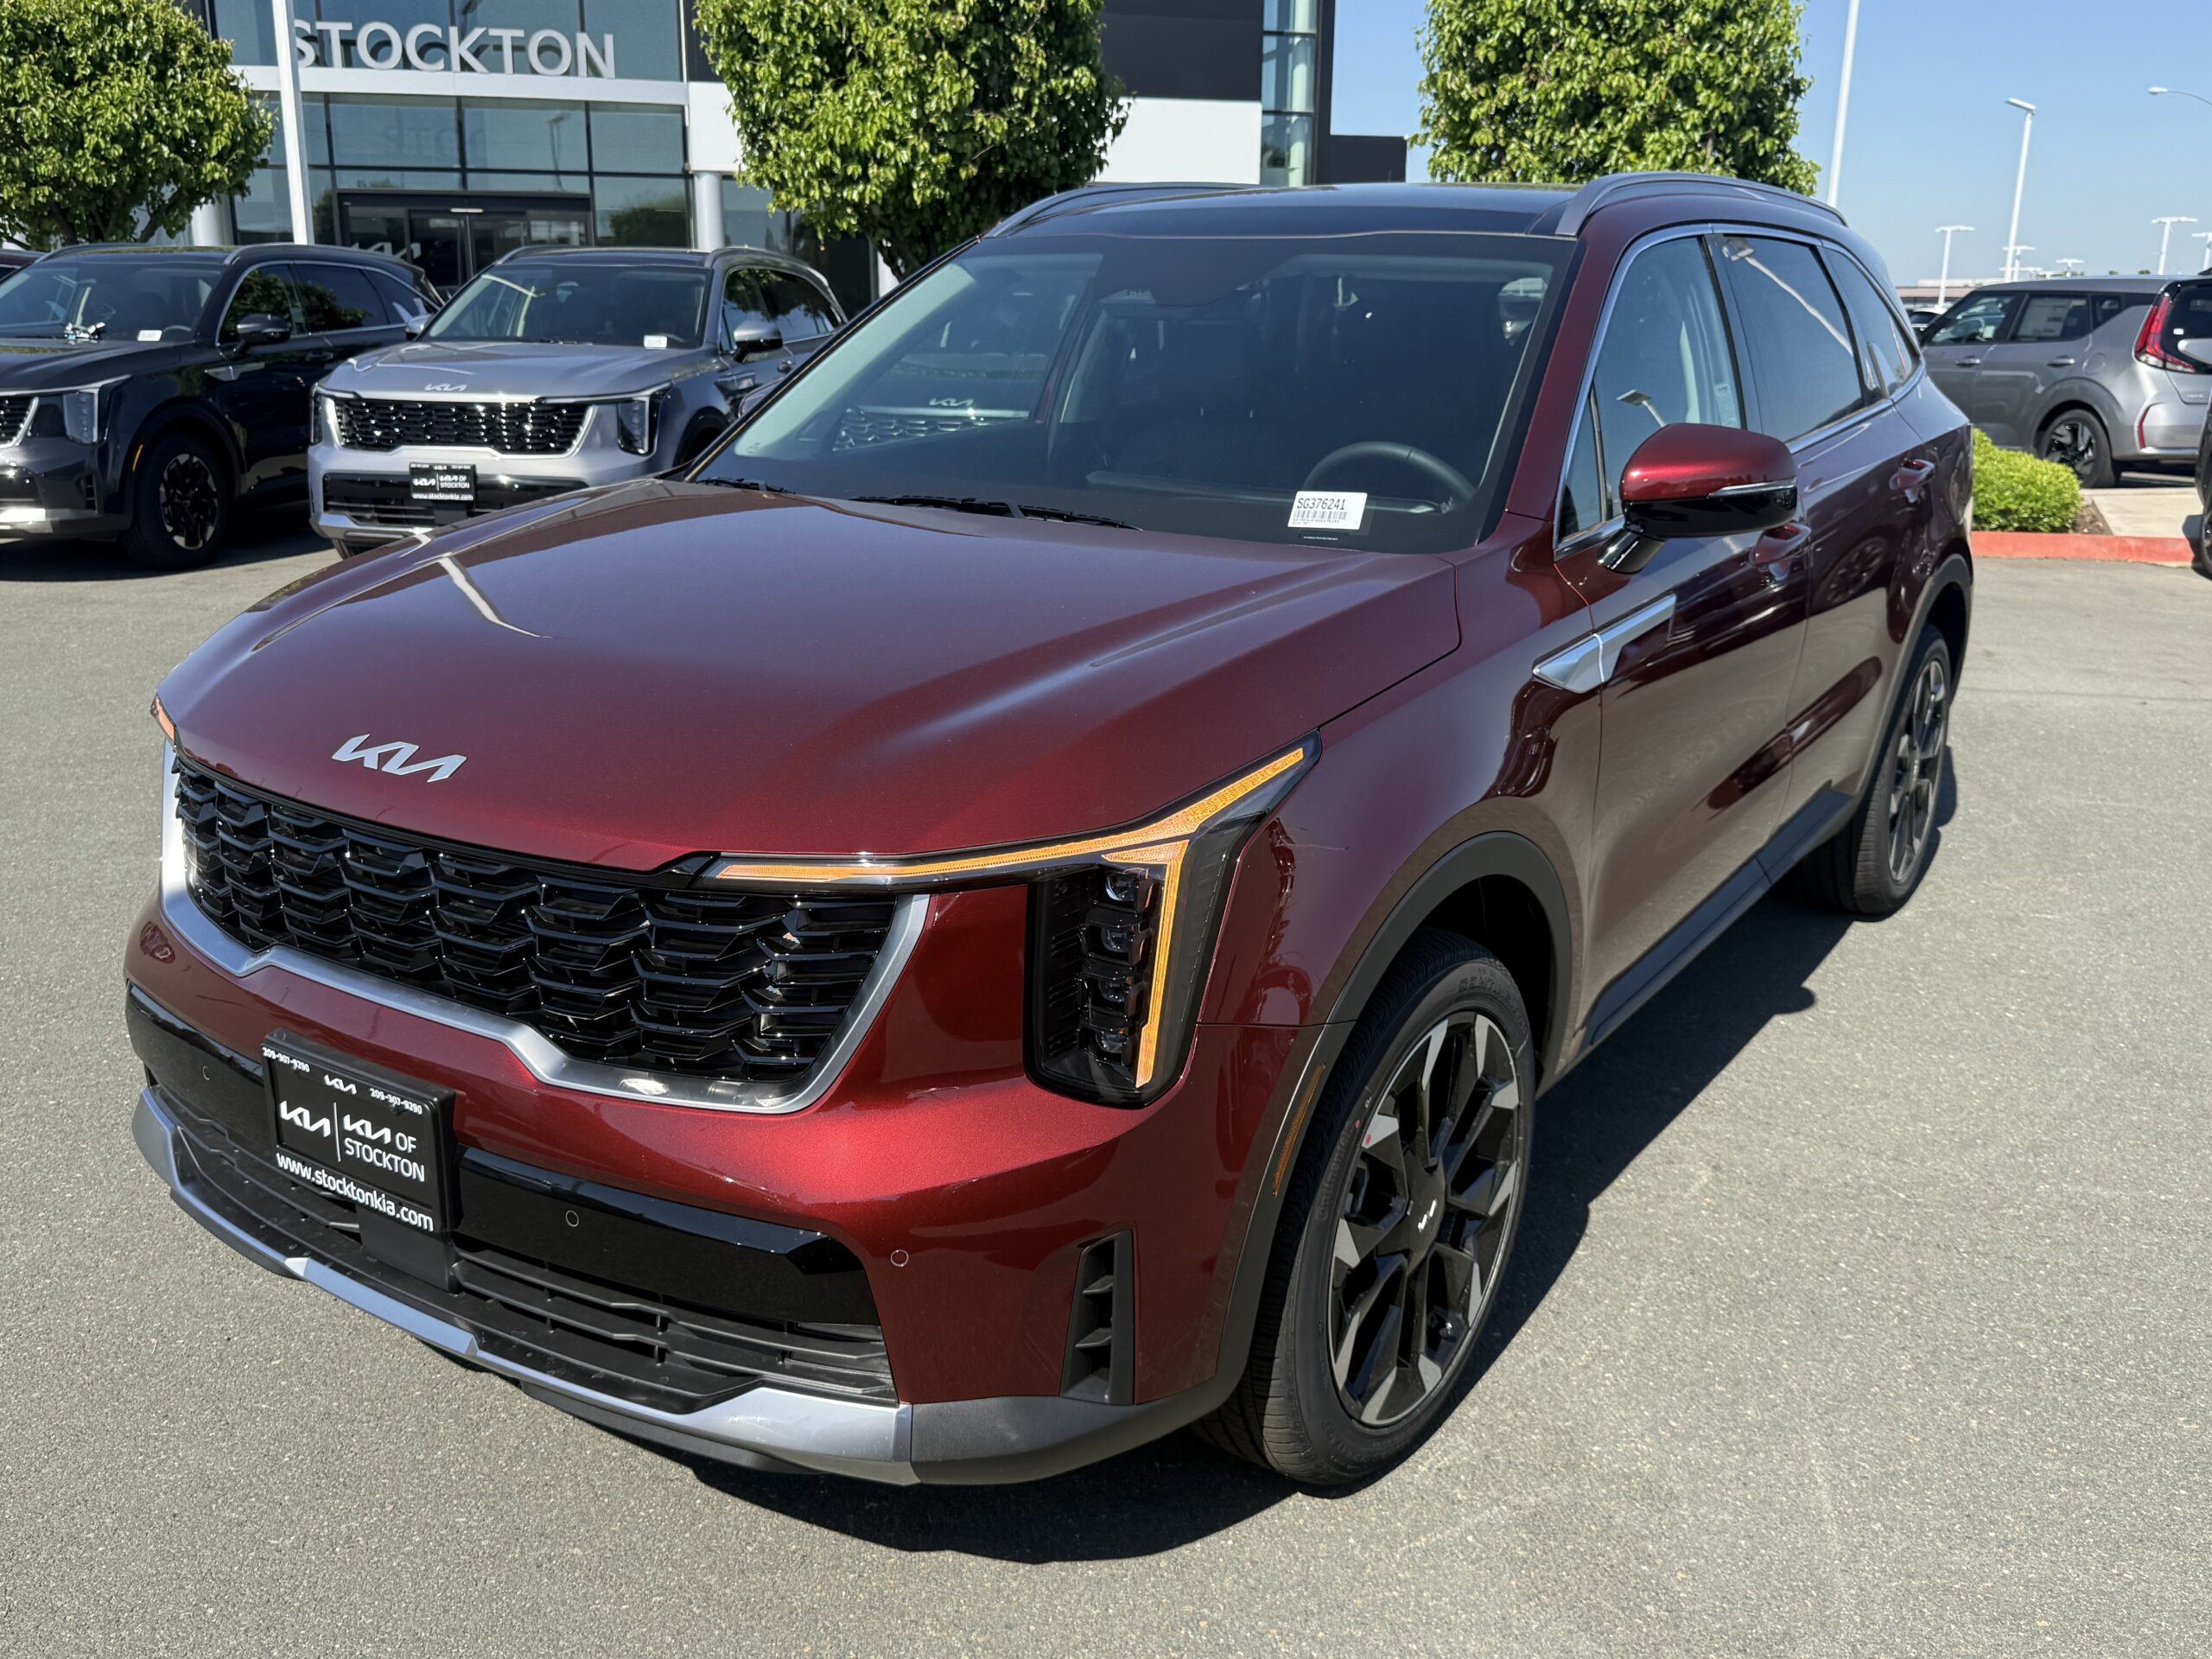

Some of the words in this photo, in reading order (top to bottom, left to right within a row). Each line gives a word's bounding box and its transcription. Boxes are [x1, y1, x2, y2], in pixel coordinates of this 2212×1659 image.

[294, 20, 615, 79] STOCKTON
[1297, 498, 1346, 510] SG376241
[332, 734, 467, 783] KIA
[324, 1075, 357, 1094] KIA
[279, 1100, 331, 1138] KIA
[343, 1114, 391, 1144] KIA
[395, 1132, 416, 1154] OF
[344, 1137, 425, 1183] STOCKTON
[276, 1153, 434, 1231] www.stocktonkia.com
